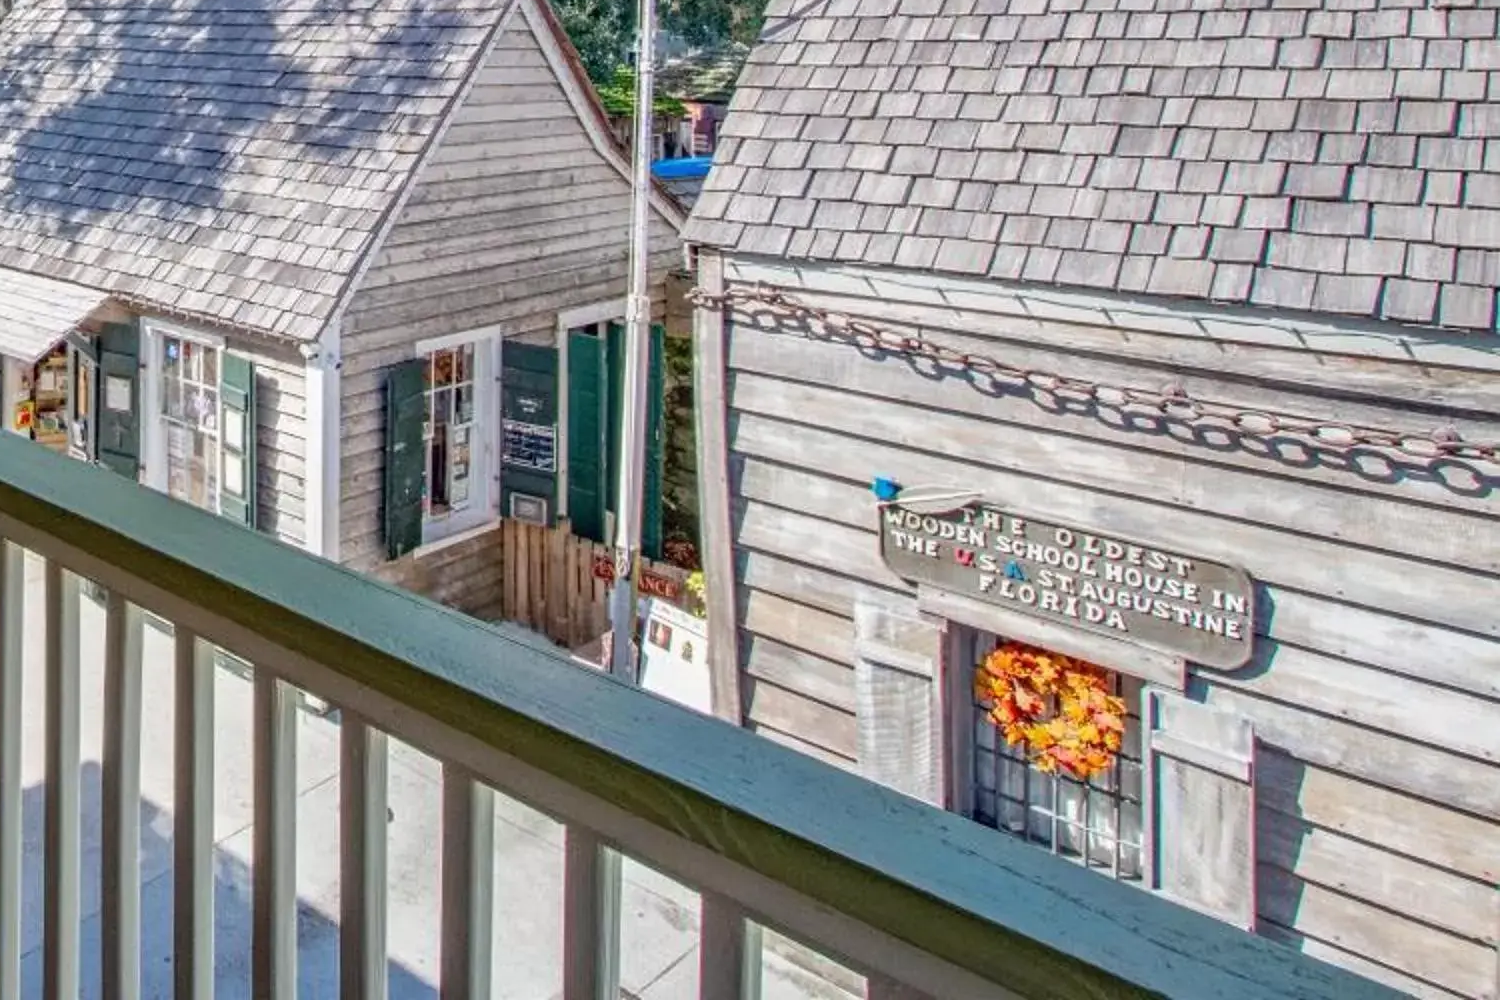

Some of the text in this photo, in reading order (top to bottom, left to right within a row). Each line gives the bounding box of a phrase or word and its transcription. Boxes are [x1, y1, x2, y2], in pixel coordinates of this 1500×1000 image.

[886, 510, 1247, 614] WOODEN SCHOOL HOUSE IN
[891, 529, 940, 558] THE
[1081, 580, 1242, 640] AUGUSTINE
[963, 508, 1192, 577] THE OLDEST
[979, 574, 1127, 632] FLORIDA
